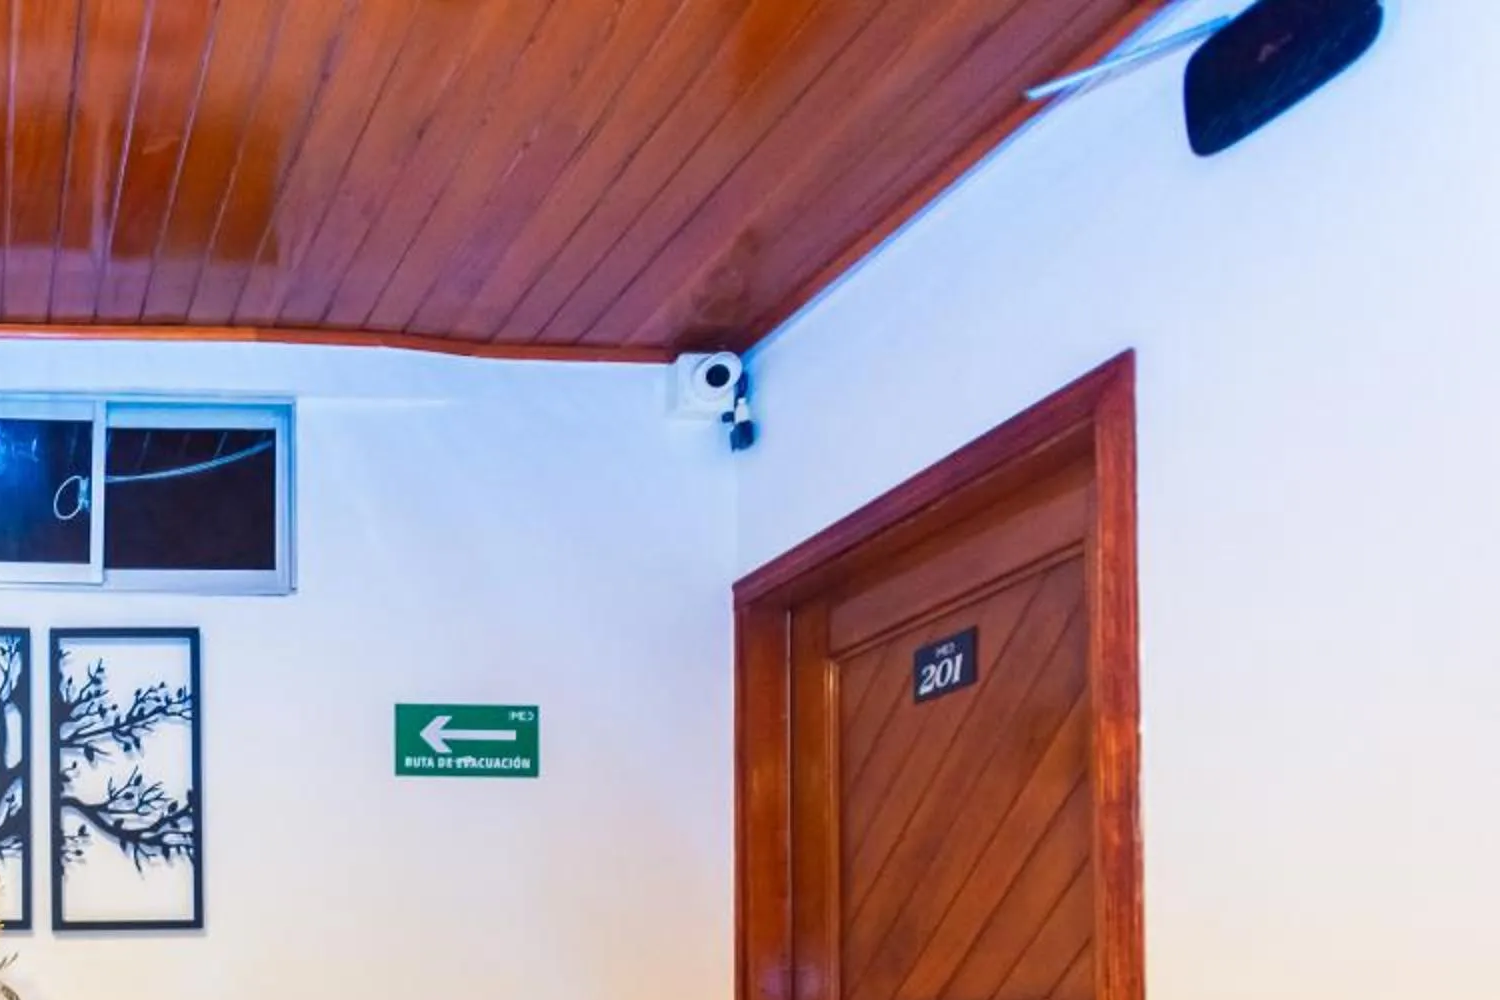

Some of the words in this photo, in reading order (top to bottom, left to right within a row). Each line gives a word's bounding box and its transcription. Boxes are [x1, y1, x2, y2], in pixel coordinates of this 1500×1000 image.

[919, 653, 963, 696] 201
[405, 756, 434, 769] RUTA
[438, 757, 452, 768] DE
[456, 756, 531, 769] EVACUACIÓN
